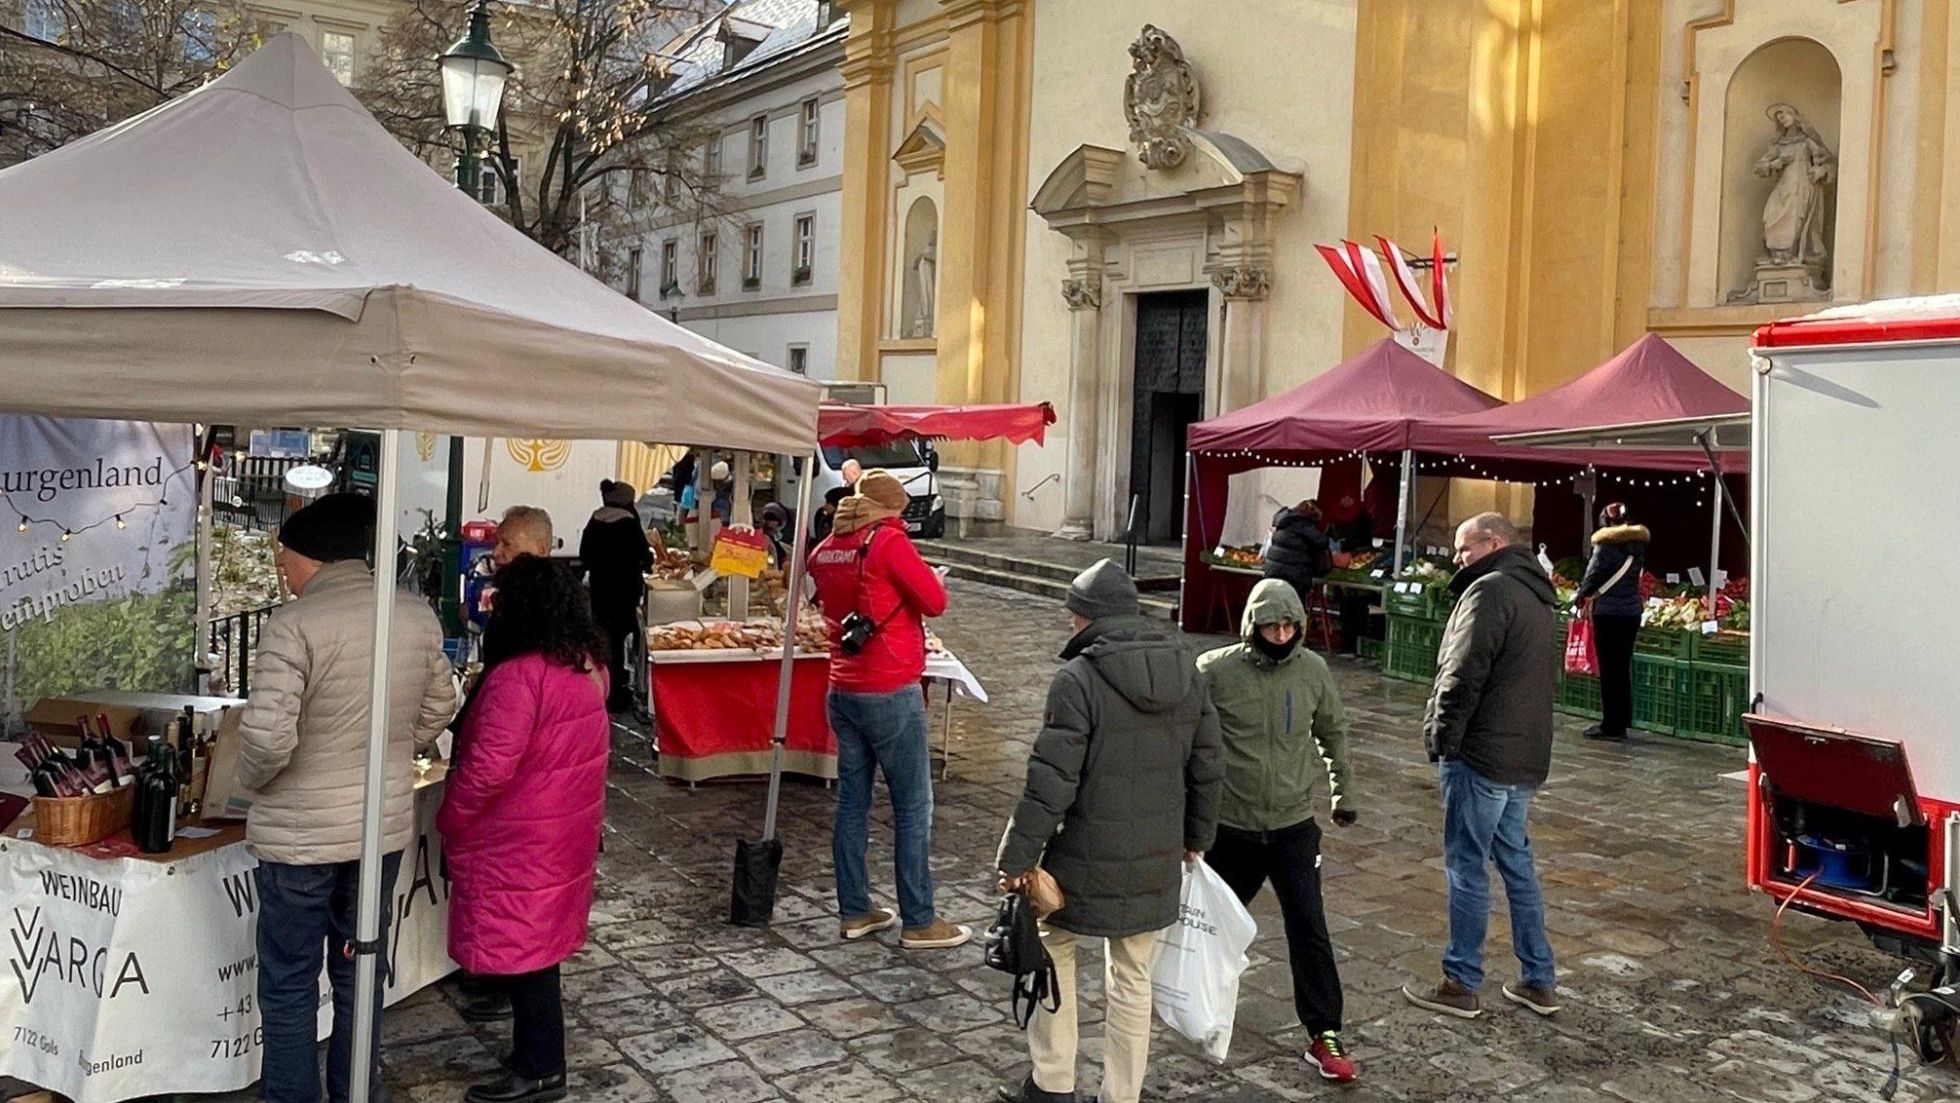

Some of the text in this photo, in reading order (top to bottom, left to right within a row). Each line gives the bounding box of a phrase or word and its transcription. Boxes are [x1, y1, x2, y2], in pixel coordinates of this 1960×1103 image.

[2, 456, 163, 501] urgenland
[1, 564, 127, 633] einproben
[38, 870, 122, 918] WEINBAU
[216, 994, 252, 1022] +43
[211, 1026, 265, 1059] 7122 G
